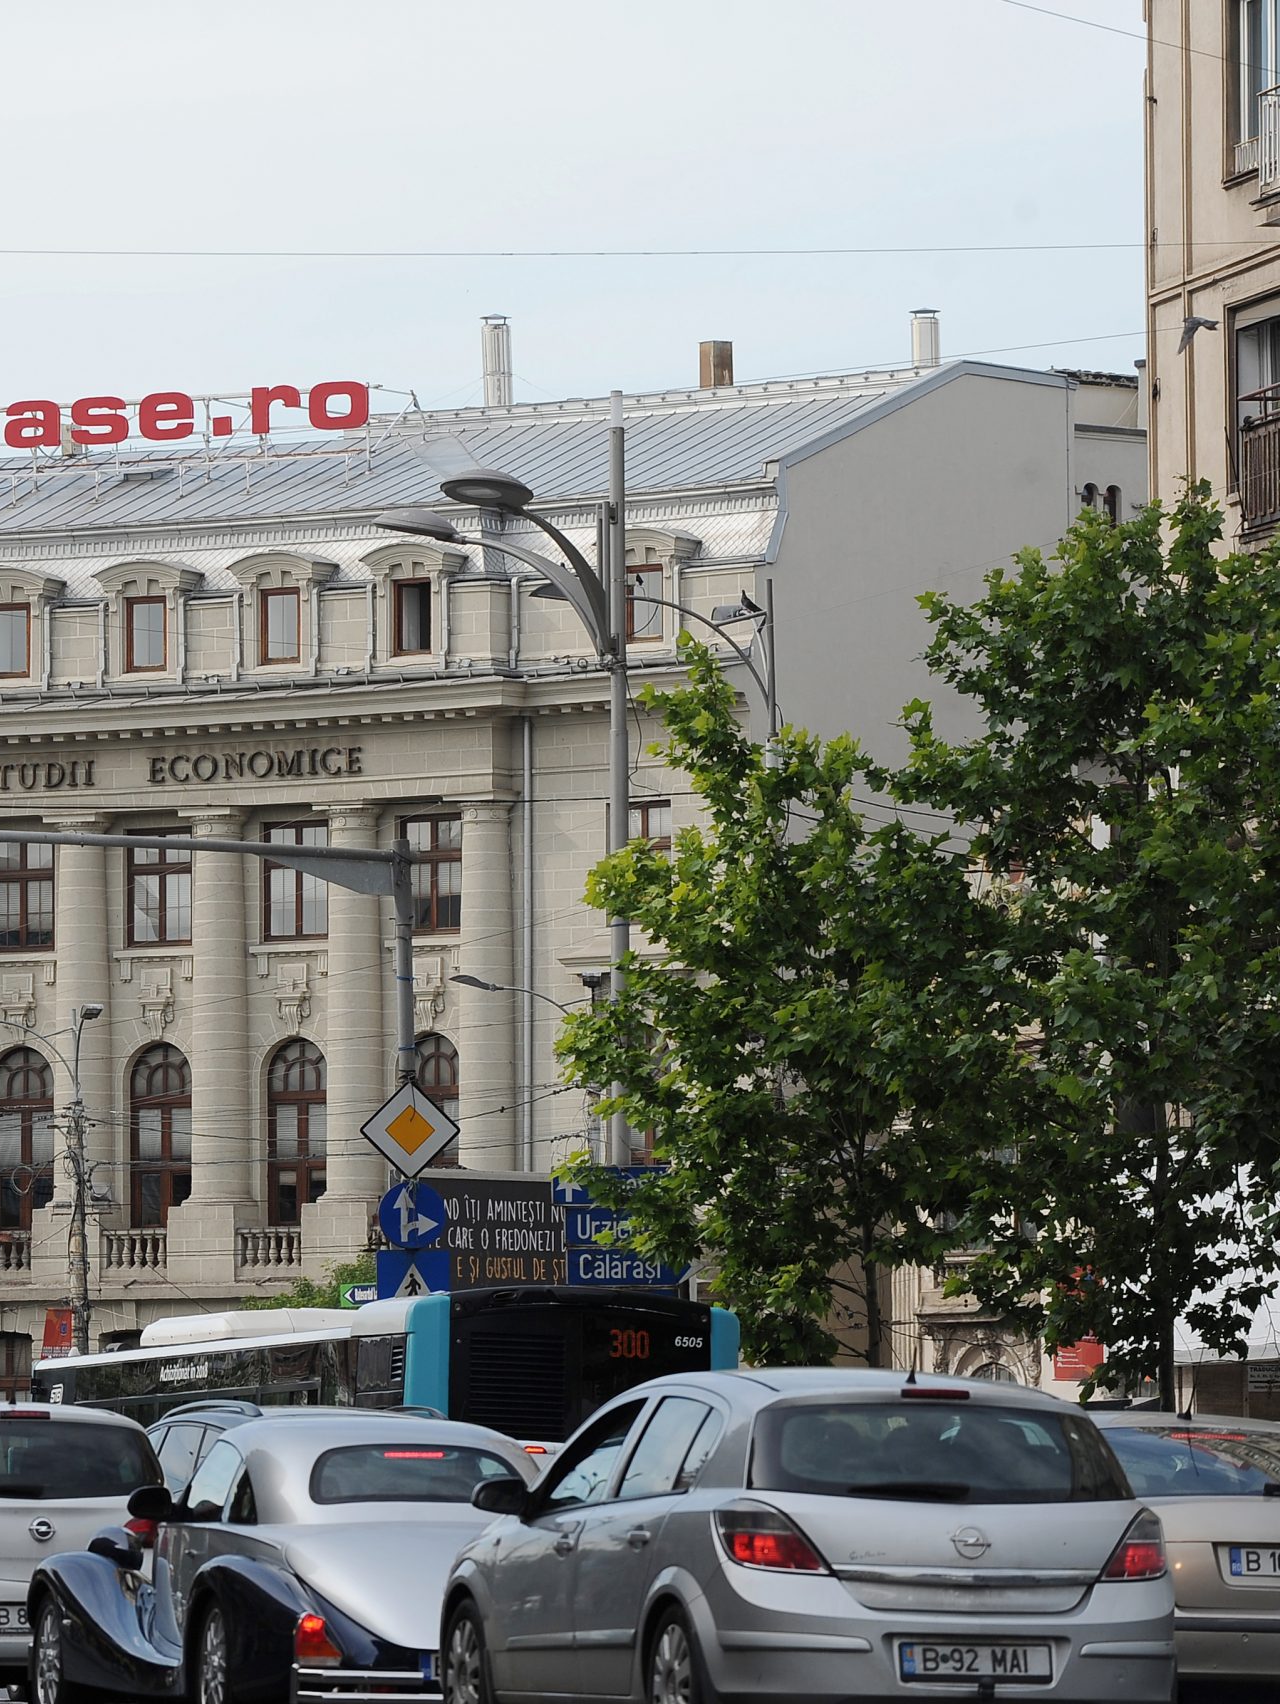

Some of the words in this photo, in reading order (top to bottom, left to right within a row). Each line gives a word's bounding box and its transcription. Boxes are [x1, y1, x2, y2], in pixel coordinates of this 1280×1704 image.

[146, 746, 363, 783] ECONOMICE
[443, 1198, 460, 1221] ND
[447, 1226, 474, 1250] CARE
[480, 1227, 490, 1250] O
[495, 1228, 556, 1253] FREDONEZI
[576, 1213, 633, 1241] Urzic
[486, 1257, 527, 1281] GUSTUL
[533, 1257, 547, 1281] DE
[553, 1258, 566, 1287] ȘT
[609, 1328, 650, 1359] 300
[674, 1335, 704, 1349] 6505
[1246, 1550, 1262, 1573] B
[1269, 1550, 1280, 1574] 1
[17, 1607, 28, 1626] 8
[921, 1647, 940, 1673] B
[949, 1648, 980, 1673] 92
[990, 1648, 1029, 1674] MAI
